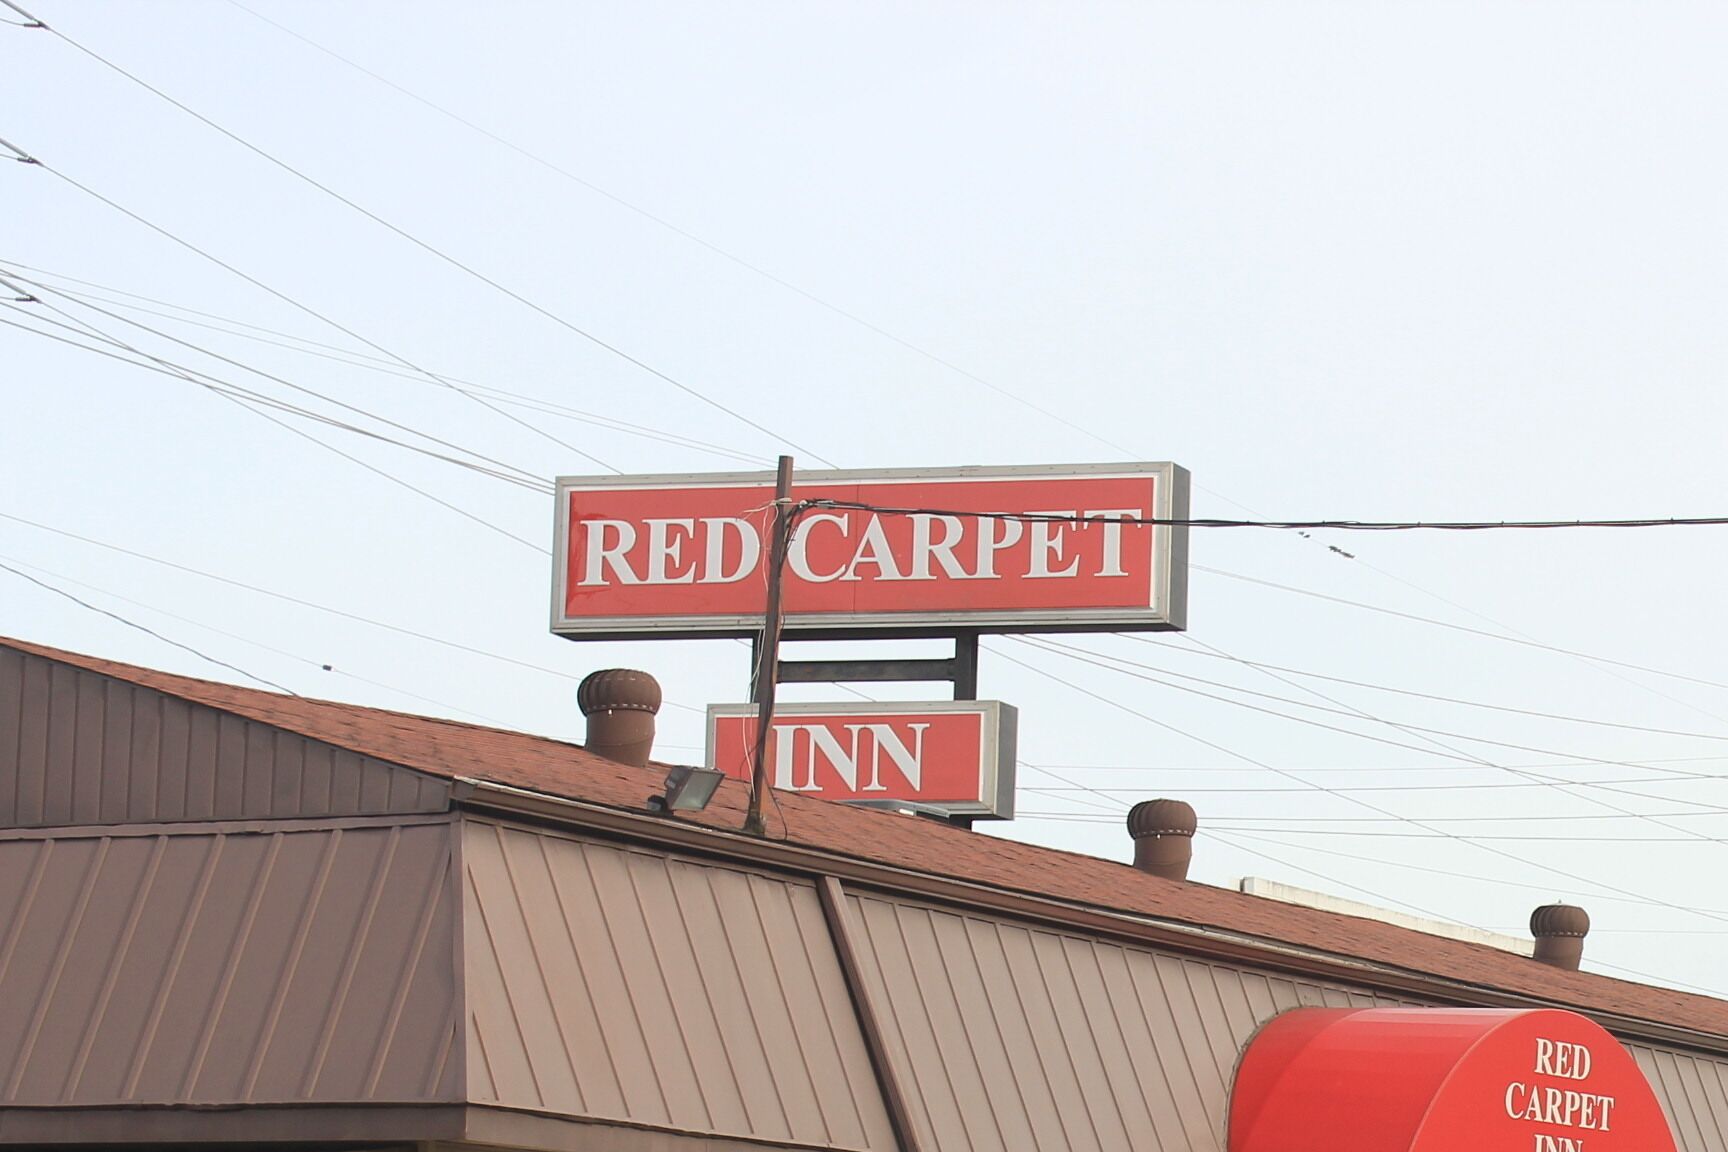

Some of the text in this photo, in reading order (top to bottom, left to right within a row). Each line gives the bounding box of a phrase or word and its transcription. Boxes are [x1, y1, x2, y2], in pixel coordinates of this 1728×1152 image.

[577, 507, 1143, 587] RED CARPET
[772, 721, 931, 793] INN
[1534, 1037, 1592, 1080] RED
[1505, 1082, 1615, 1131] CARPET
